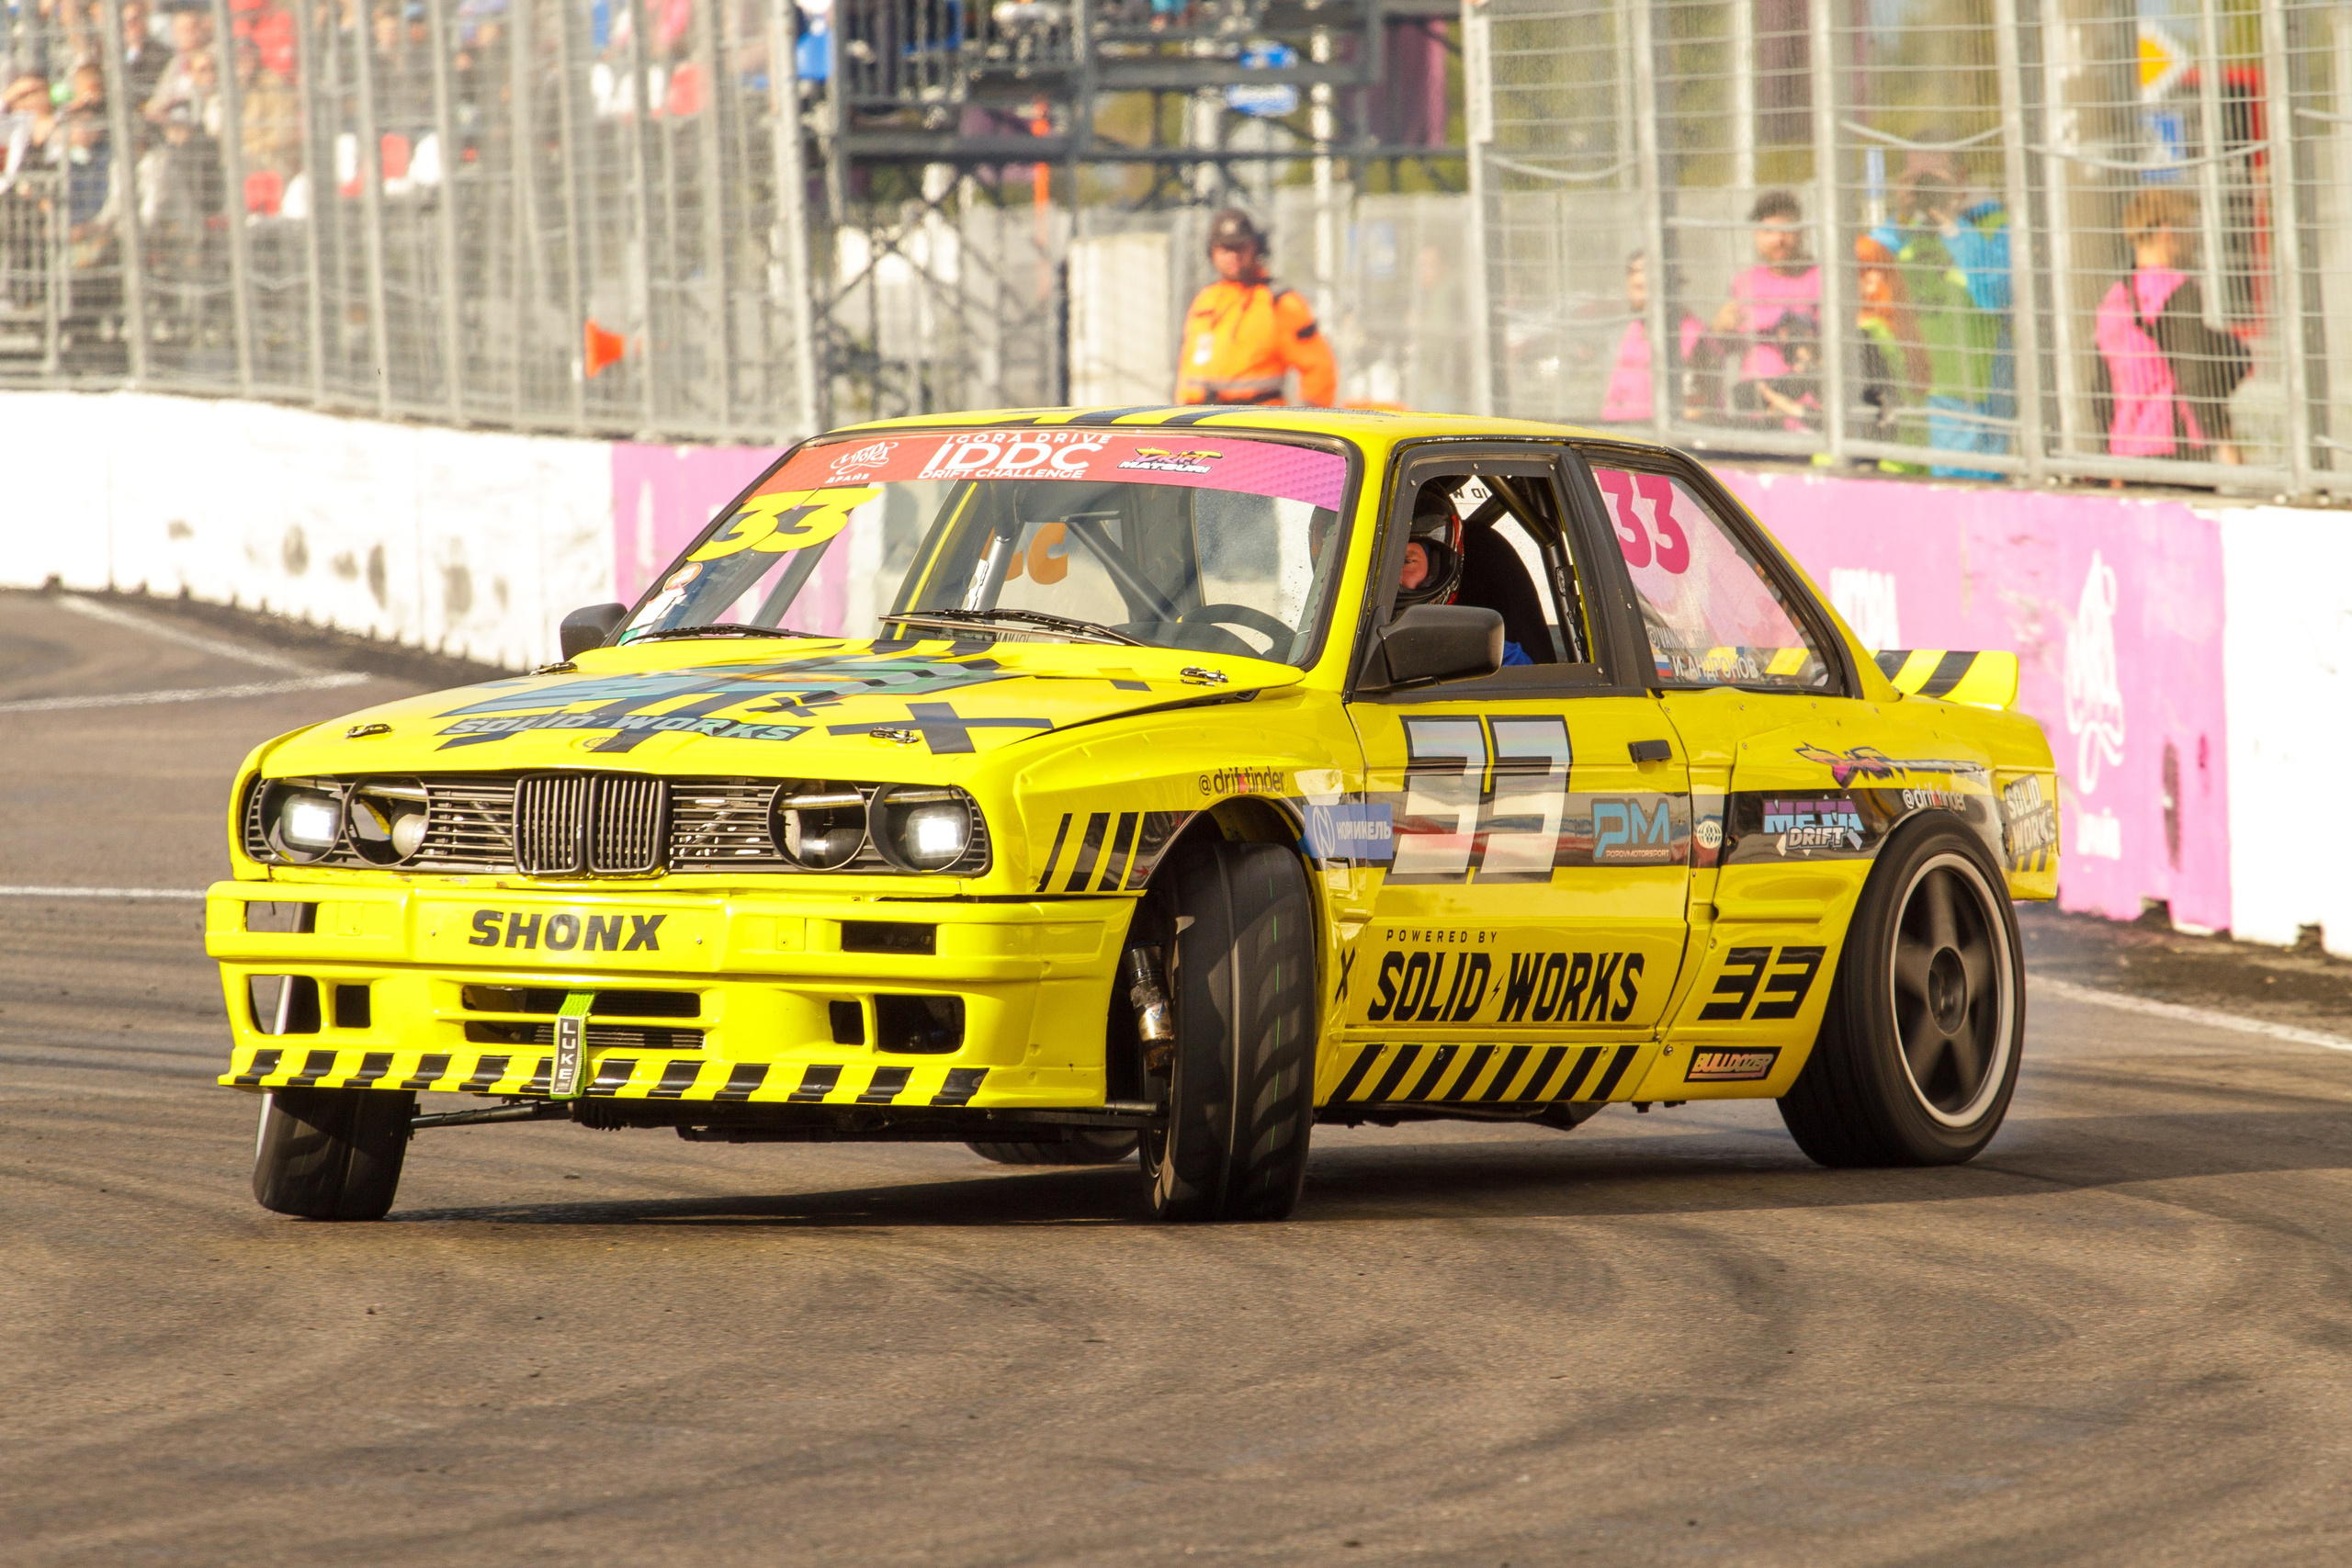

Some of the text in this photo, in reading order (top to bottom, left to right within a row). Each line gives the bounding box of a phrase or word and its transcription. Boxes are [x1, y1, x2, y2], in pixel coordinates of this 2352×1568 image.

[924, 442, 1103, 470] IDDC
[1035, 433, 1113, 444] DRIVE
[917, 468, 1087, 479] DRIFT CHALLENGE
[686, 487, 885, 562] 33
[1595, 468, 1690, 574] 33
[446, 716, 597, 733] SOLID
[608, 716, 801, 740] WORKS
[1382, 715, 1573, 885] 33
[2004, 777, 2042, 820] SOLID
[1786, 827, 1847, 847] DRIFT
[468, 908, 667, 952] SHONX
[1385, 930, 1498, 944] POWERED BY
[1367, 951, 1492, 1022] SOLID
[1496, 952, 1645, 1022] WORKS
[1698, 946, 1827, 1021] 33
[558, 1021, 577, 1080] LUKE
